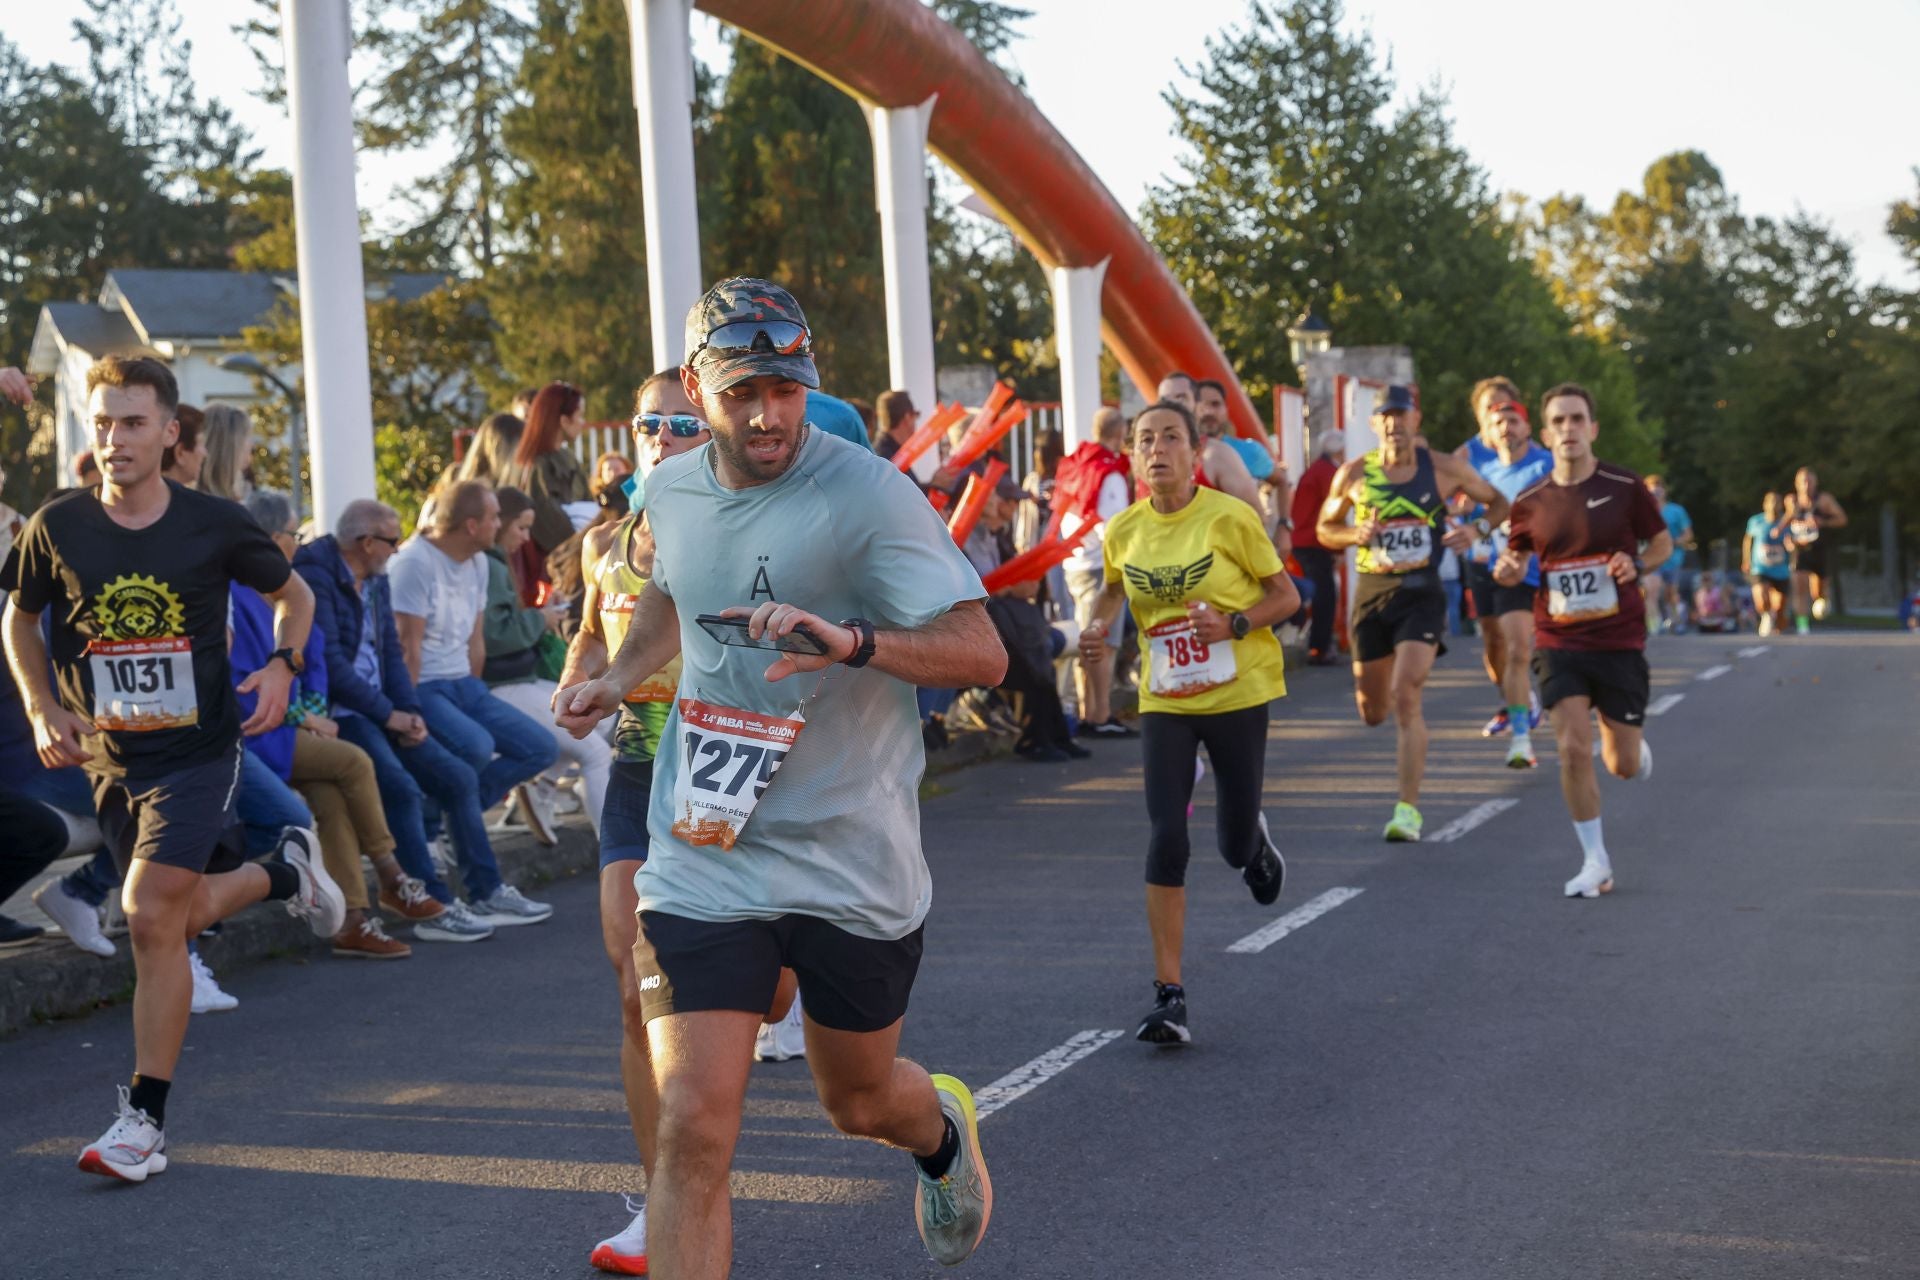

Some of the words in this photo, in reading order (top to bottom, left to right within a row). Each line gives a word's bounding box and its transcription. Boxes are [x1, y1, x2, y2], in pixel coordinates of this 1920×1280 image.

[1375, 527, 1423, 551] 1248
[750, 555, 775, 601] Ä
[1559, 571, 1598, 597] 812
[1163, 634, 1210, 669] 189
[104, 657, 175, 694] 1031
[717, 716, 744, 729] MBA
[768, 725, 796, 738] GIJÓN
[692, 800, 728, 813] UILLERMO
[728, 807, 751, 819] PÉRE
